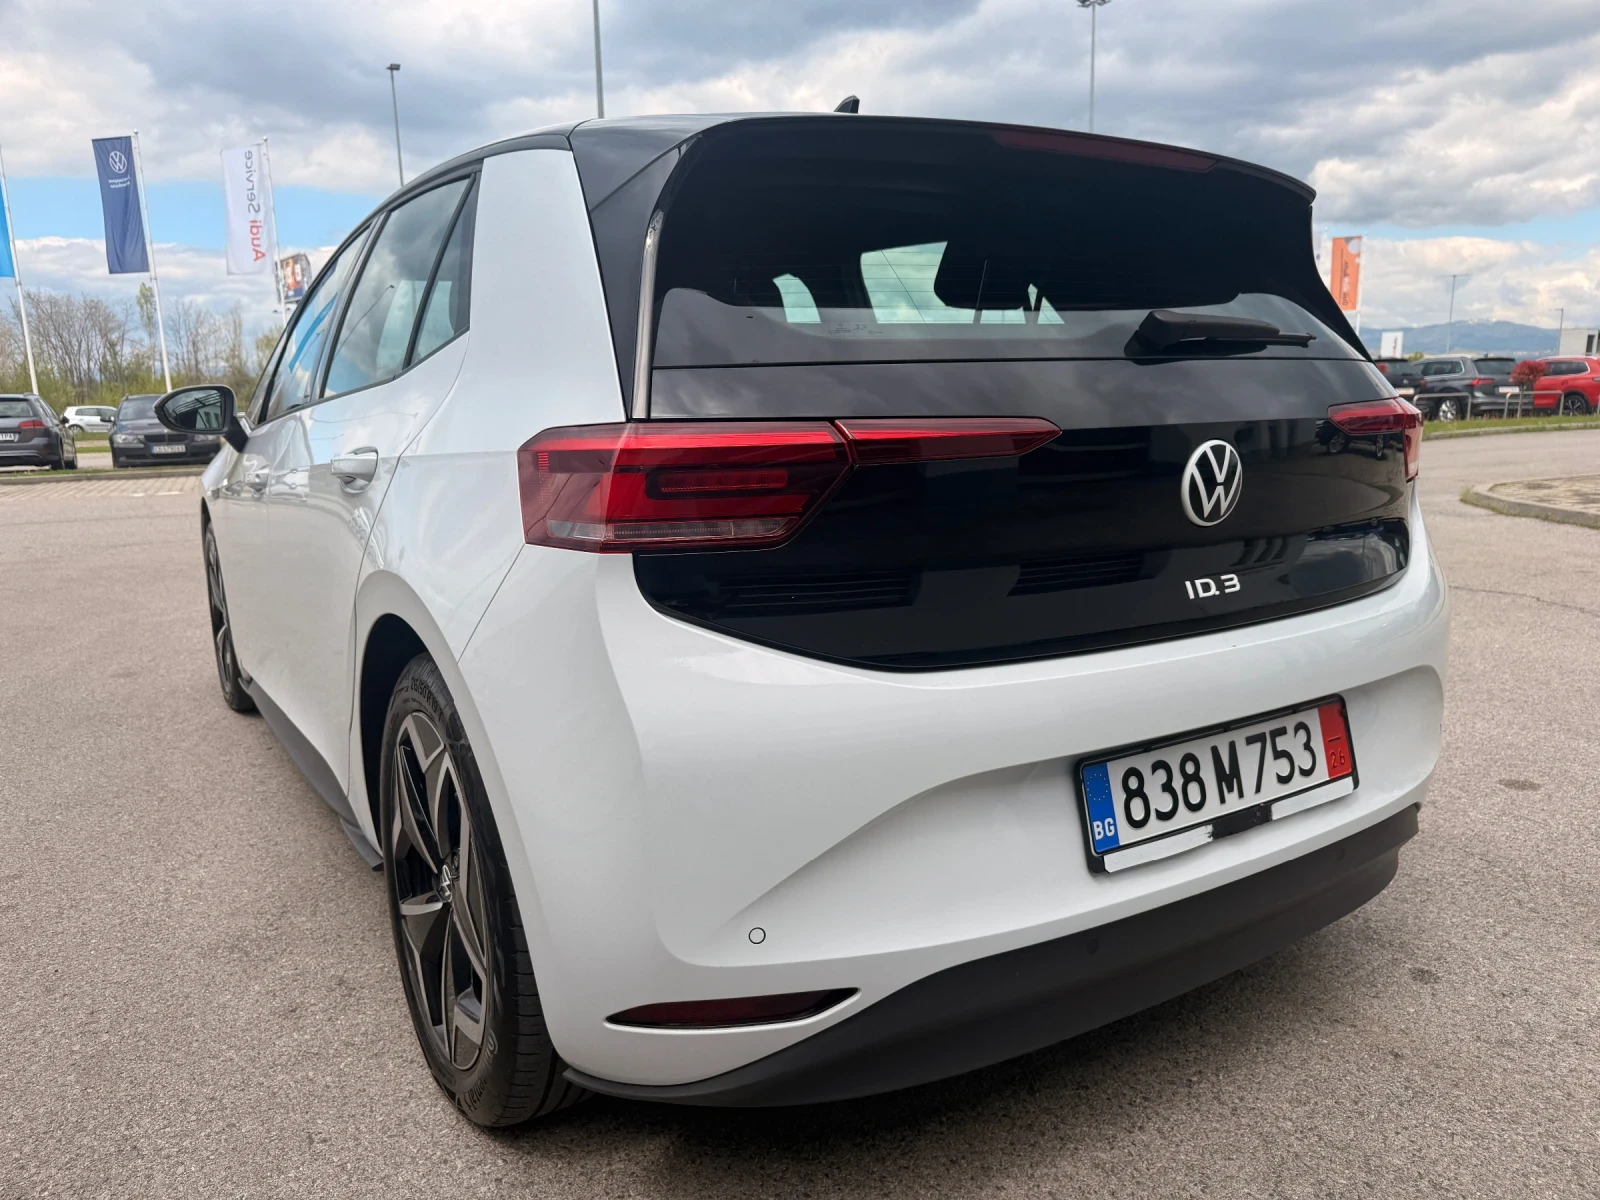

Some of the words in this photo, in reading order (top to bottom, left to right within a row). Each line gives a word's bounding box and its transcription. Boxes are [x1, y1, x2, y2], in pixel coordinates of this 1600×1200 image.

[1185, 573, 1241, 600] ID.3
[1330, 748, 1346, 769] 26
[1092, 817, 1116, 840] BG
